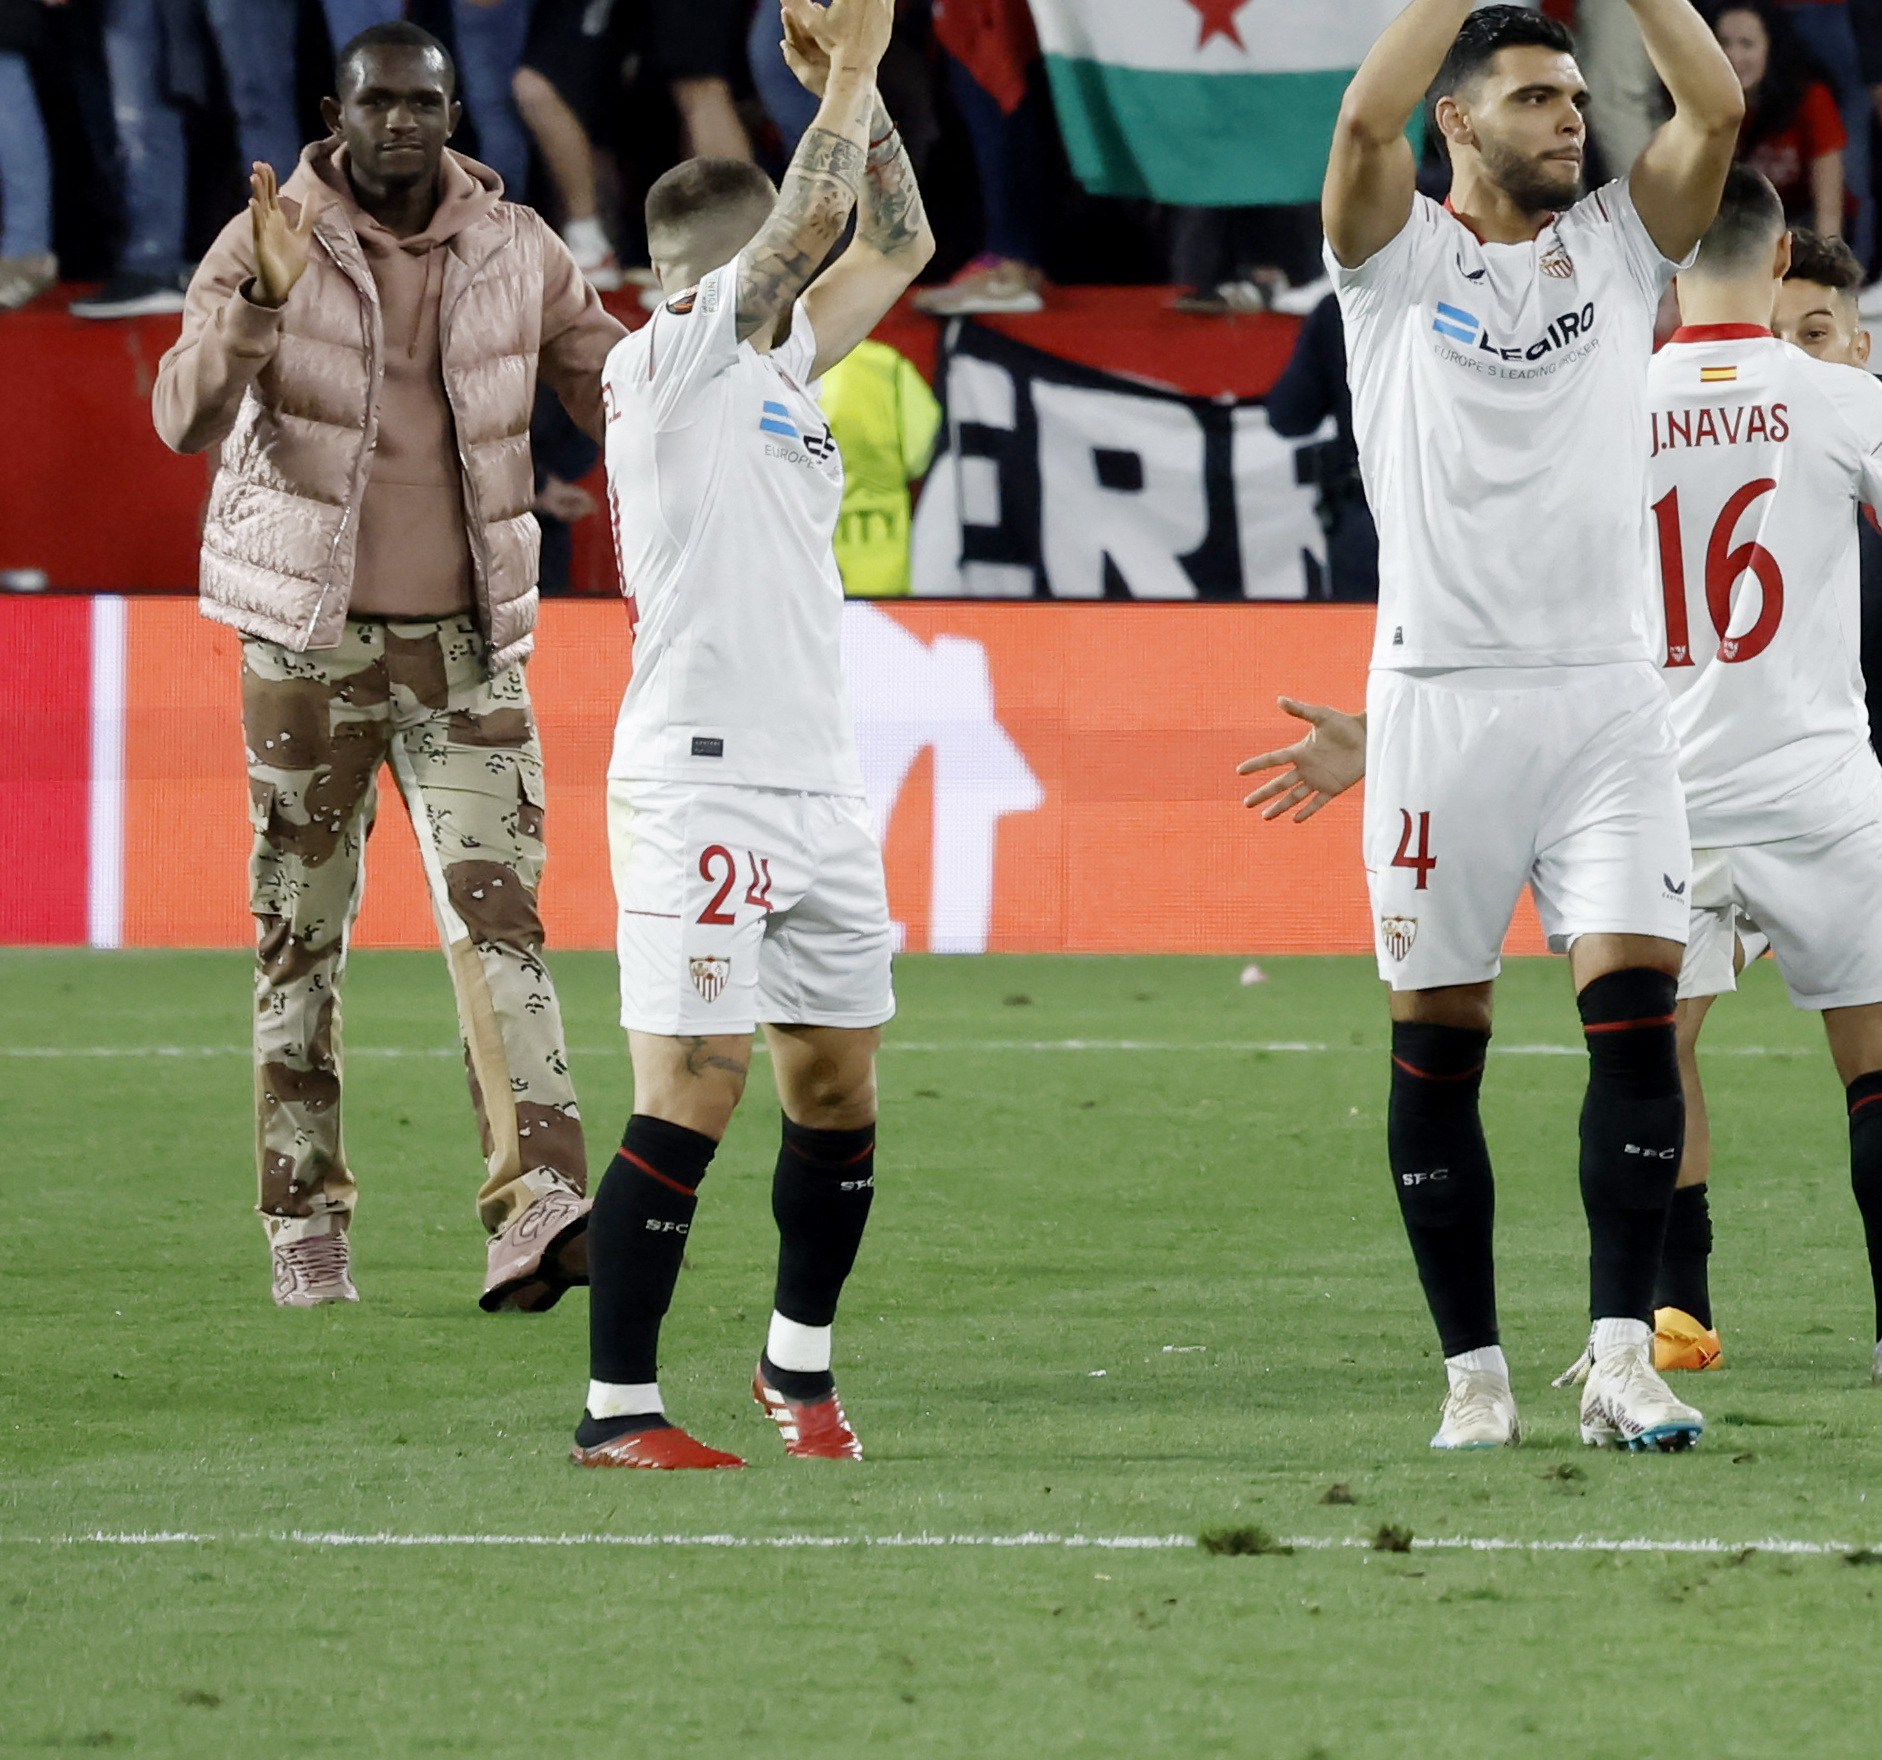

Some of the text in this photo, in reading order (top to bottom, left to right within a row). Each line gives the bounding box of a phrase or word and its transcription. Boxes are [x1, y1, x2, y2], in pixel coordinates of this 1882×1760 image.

[1651, 403, 1789, 458] J.NAVAS
[1651, 477, 1784, 668] 16
[1390, 807, 1438, 891] 4
[695, 843, 776, 925] 24
[1402, 1168, 1449, 1186] SFC
[645, 1218, 689, 1235] SFC
